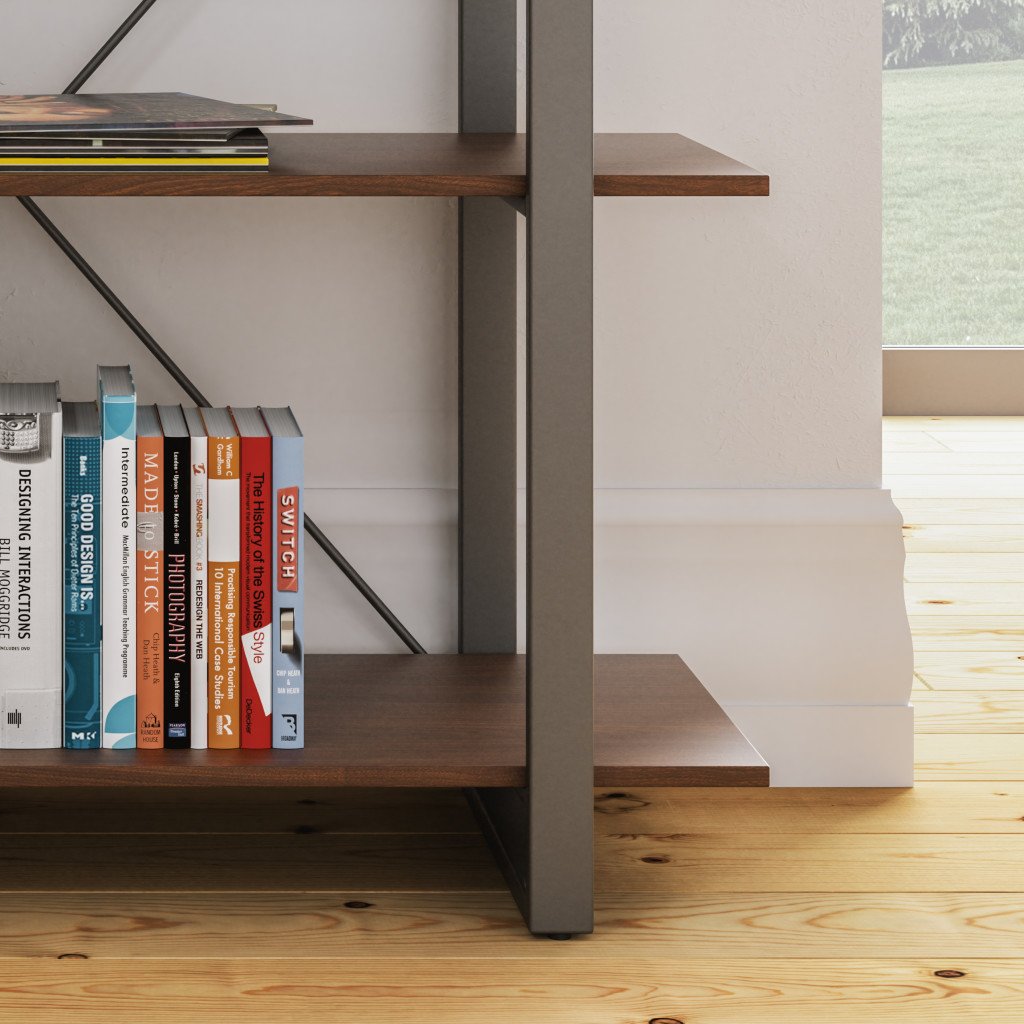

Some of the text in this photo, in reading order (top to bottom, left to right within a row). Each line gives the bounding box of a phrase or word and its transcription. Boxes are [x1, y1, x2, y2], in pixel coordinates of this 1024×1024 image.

[80, 494, 94, 531] GOOD
[144, 453, 158, 613] MADE to STICK
[281, 495, 295, 578] SWITCH
[18, 470, 31, 639] DESIGNING INTERACTIONS
[70, 524, 79, 558] Principles
[80, 535, 94, 584] DESIGN
[0, 538, 10, 639] BILL MOGGRIDGE
[196, 563, 202, 571] #3
[215, 568, 224, 579] 10
[226, 568, 235, 609] Practising
[251, 472, 264, 664] The History of the Swiss Style
[168, 554, 185, 662] PHOTOGRAPHY
[215, 582, 224, 644] International
[151, 633, 160, 651] Chip
[215, 647, 224, 671] Case
[226, 613, 235, 664] Responsible
[215, 675, 224, 709] Studies
